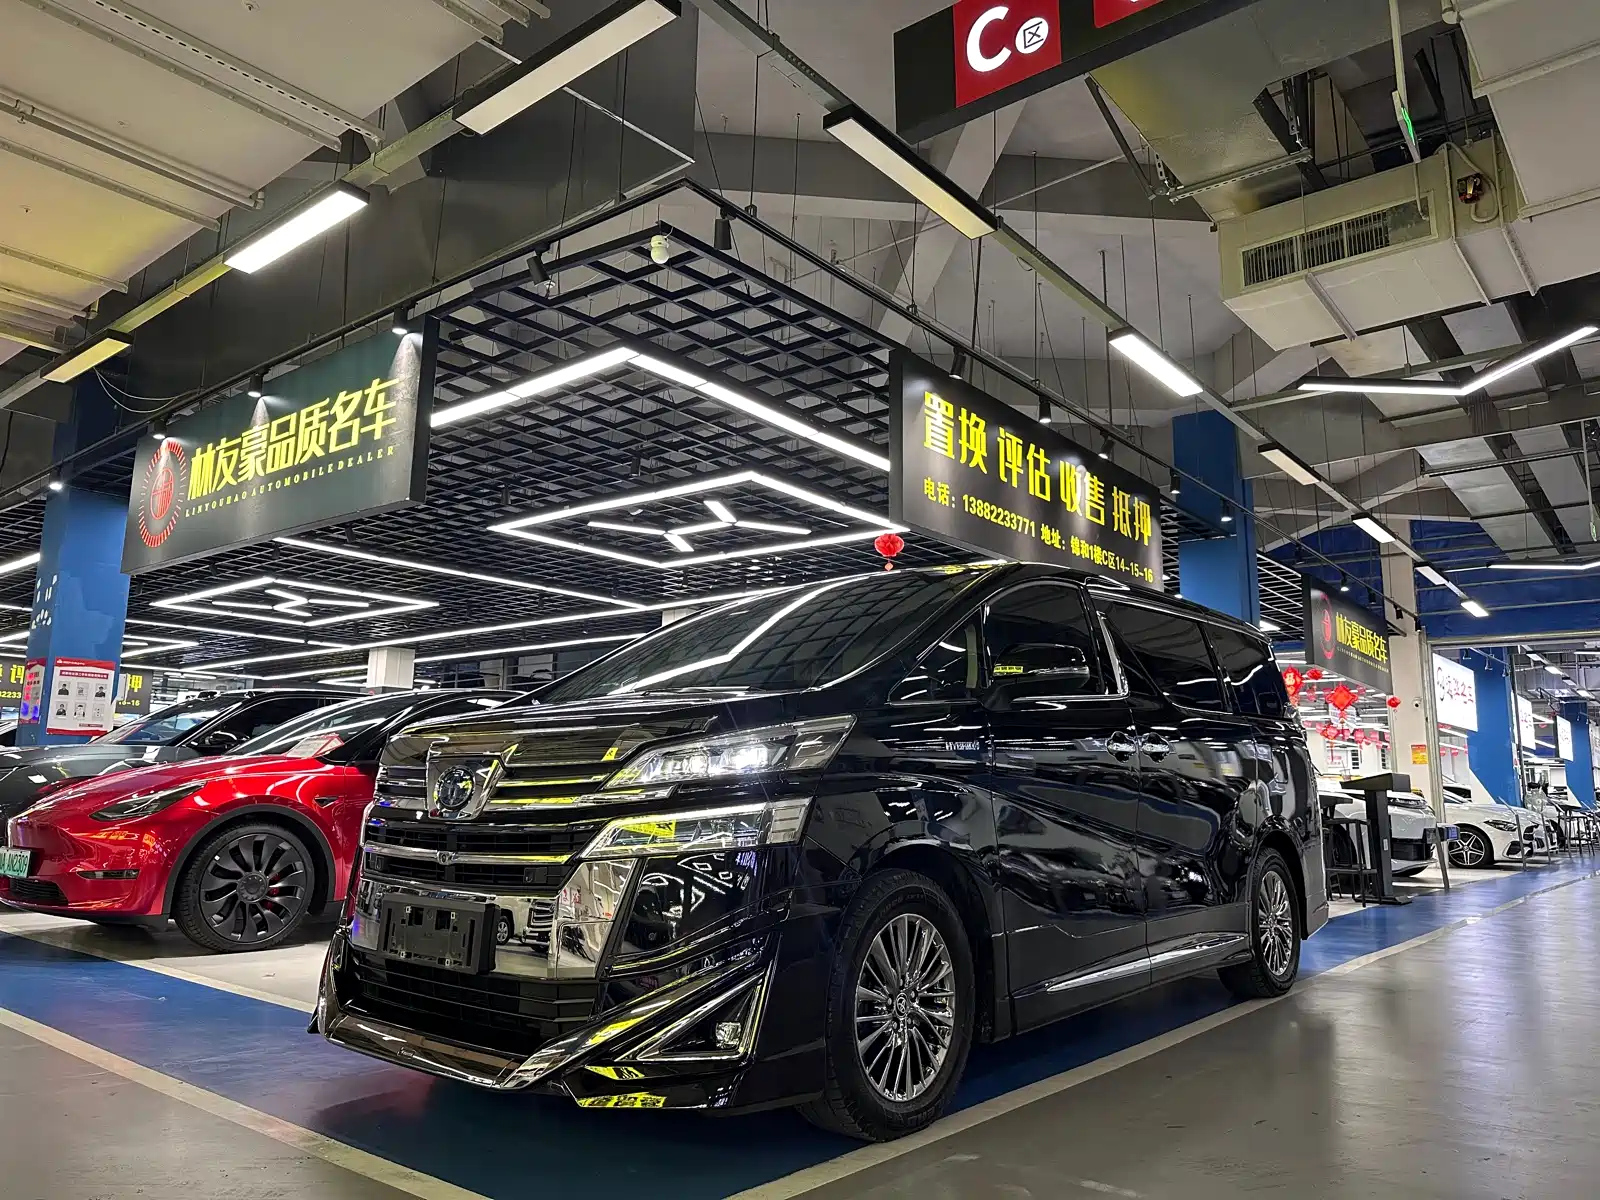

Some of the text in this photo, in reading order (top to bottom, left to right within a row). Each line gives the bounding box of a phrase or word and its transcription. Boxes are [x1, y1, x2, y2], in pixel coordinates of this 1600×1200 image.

[188, 378, 399, 500] 林友豪品质名车
[924, 391, 1152, 546] 置换 评估 收售 抵押
